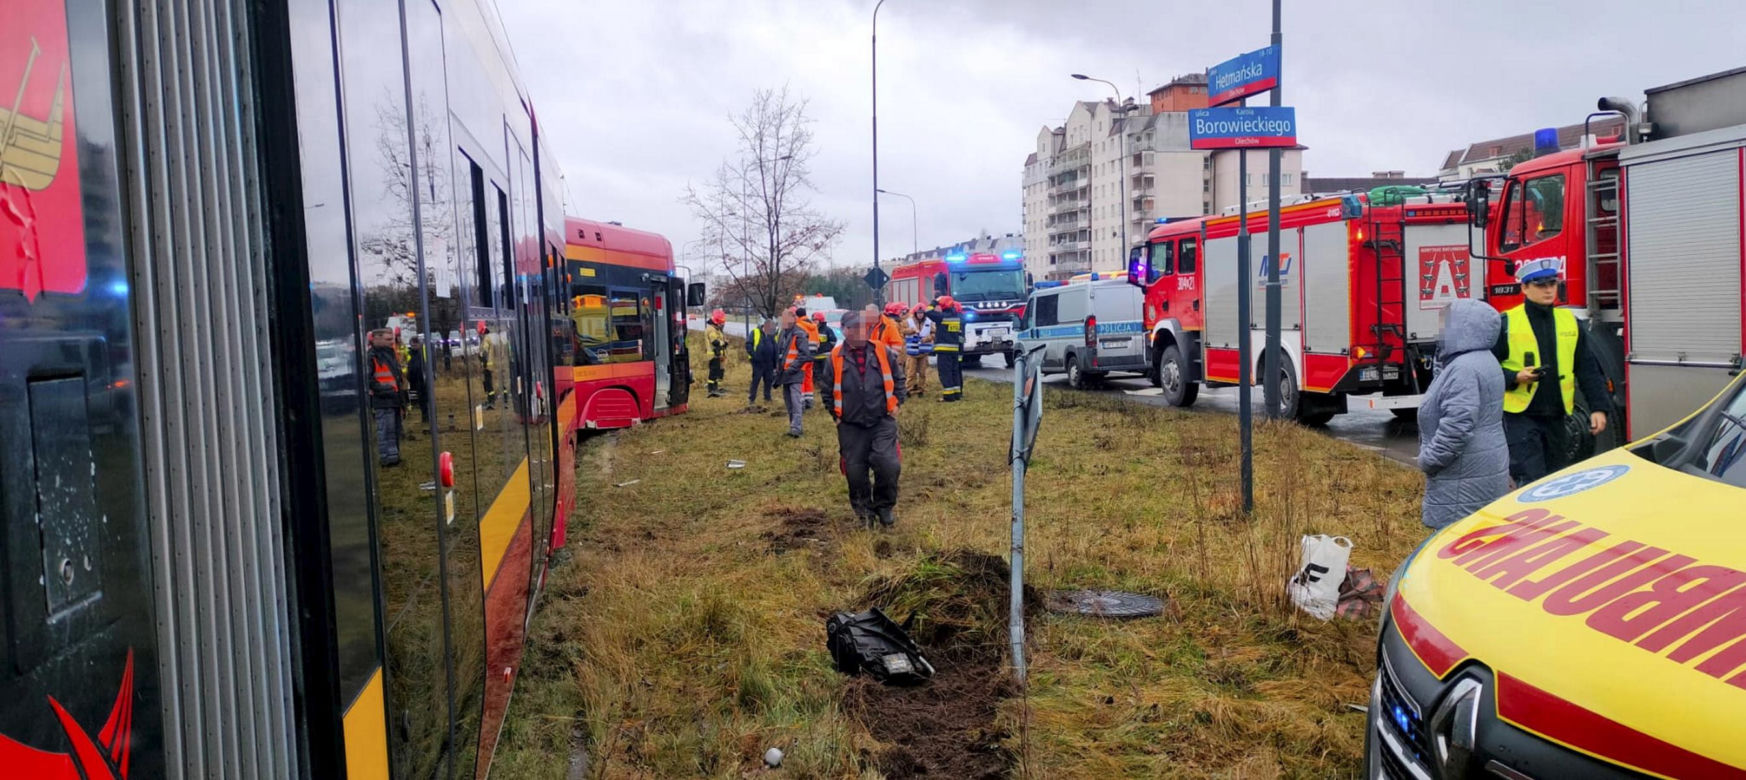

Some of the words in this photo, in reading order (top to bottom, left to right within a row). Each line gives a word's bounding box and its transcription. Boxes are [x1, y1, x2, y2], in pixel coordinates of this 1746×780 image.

[1216, 62, 1262, 89] Hetmańska
[1196, 117, 1291, 136] Borowieckiego
[1100, 322, 1132, 333] POLICJA
